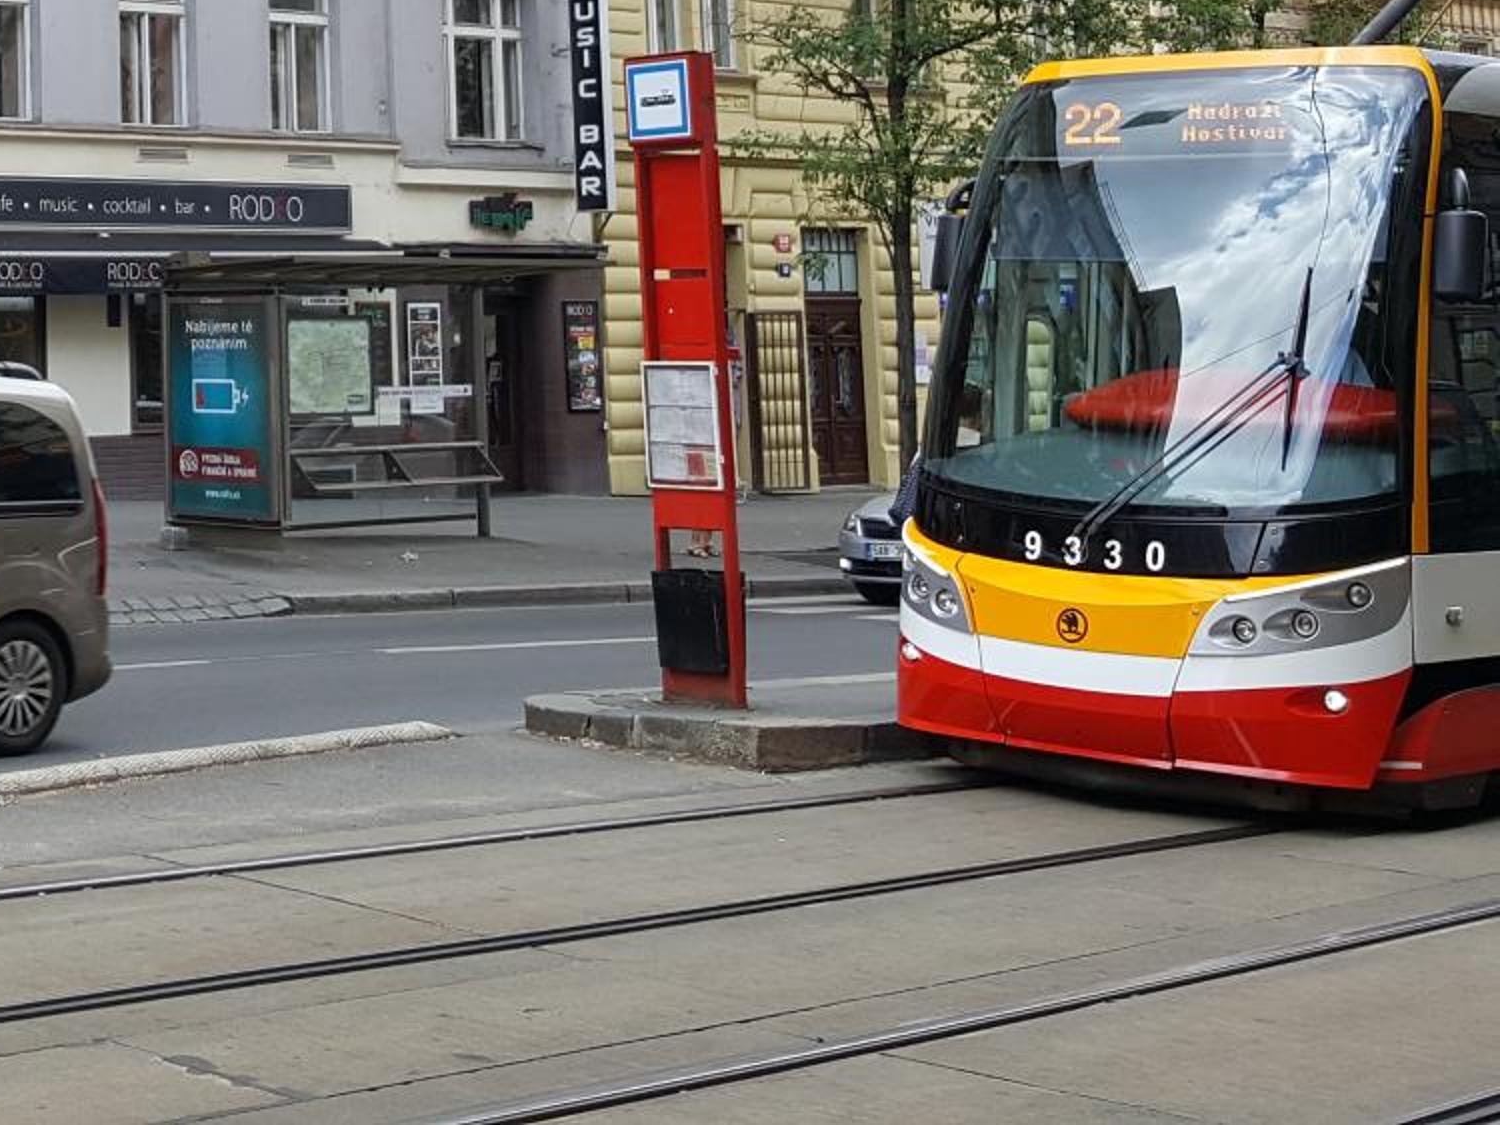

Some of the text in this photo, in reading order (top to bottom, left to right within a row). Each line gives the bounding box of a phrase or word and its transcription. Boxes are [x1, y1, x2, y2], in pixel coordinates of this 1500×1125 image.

[1064, 102, 1123, 145] 22
[579, 124, 602, 197] BAR
[39, 197, 78, 213] music
[103, 196, 151, 214] cocktail
[175, 197, 196, 215] bar
[229, 193, 303, 223] RODEO
[107, 261, 161, 281] RODEO
[1024, 530, 1166, 572] 9330
